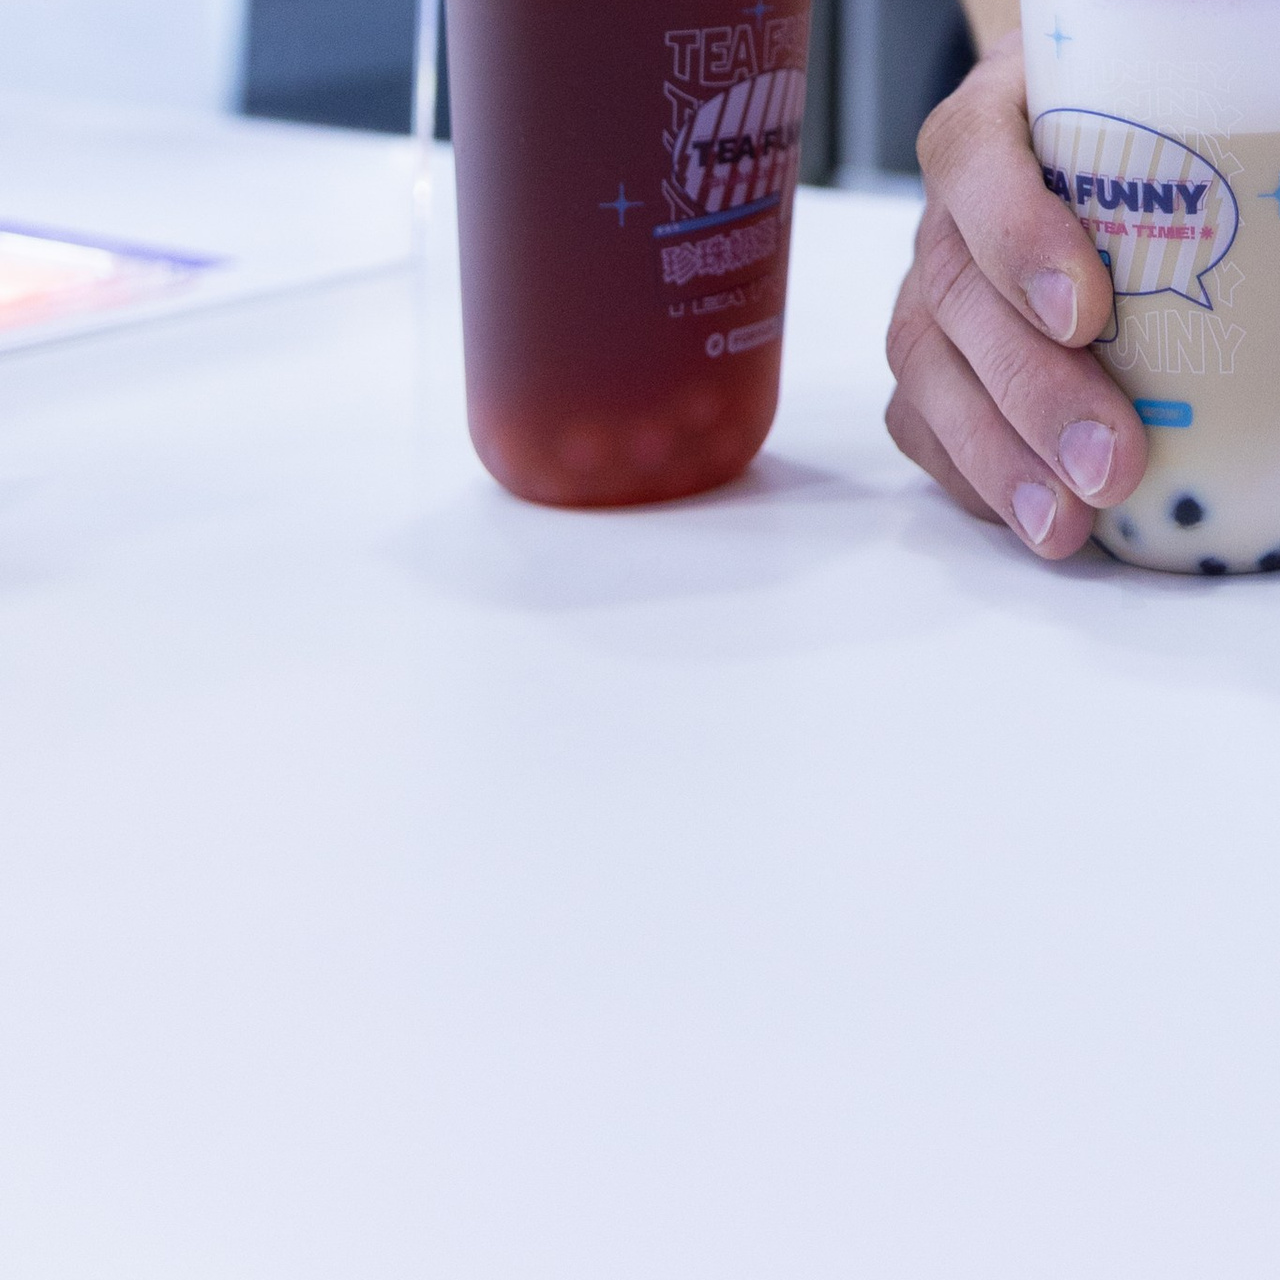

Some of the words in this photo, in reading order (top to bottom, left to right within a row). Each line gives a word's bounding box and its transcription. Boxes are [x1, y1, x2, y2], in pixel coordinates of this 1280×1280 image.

[665, 23, 758, 87] TEA
[1097, 59, 1245, 95] UNNY
[693, 134, 755, 167] TEA
[1042, 165, 1071, 202] EA
[1075, 174, 1208, 215] FUNNY
[1092, 218, 1129, 237] TEA
[1132, 223, 1196, 240] TIME!
[1107, 309, 1247, 374] UNNY
